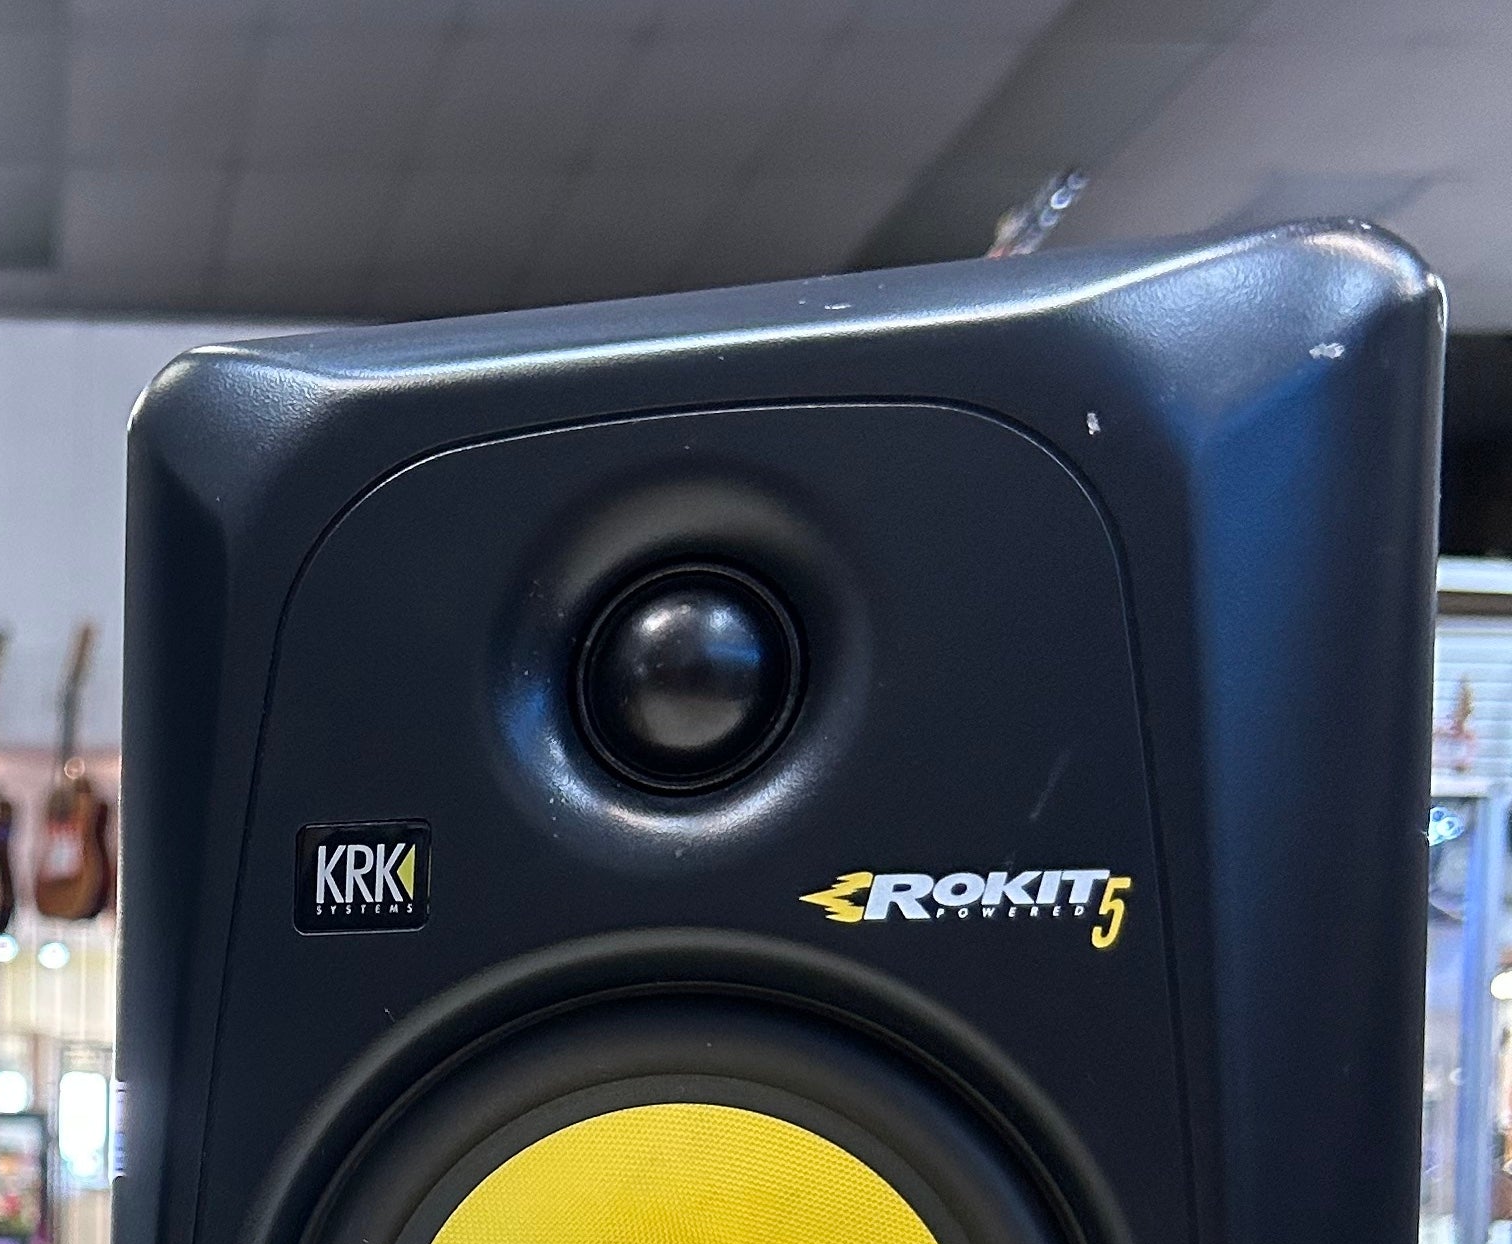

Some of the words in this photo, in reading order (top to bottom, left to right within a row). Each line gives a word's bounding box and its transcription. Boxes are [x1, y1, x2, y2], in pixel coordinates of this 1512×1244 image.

[316, 842, 407, 904] KRK
[316, 903, 414, 916] SYSTEMS
[863, 869, 1111, 921] ROKIT
[1091, 876, 1132, 949] 5
[935, 904, 1085, 919] POWERED
